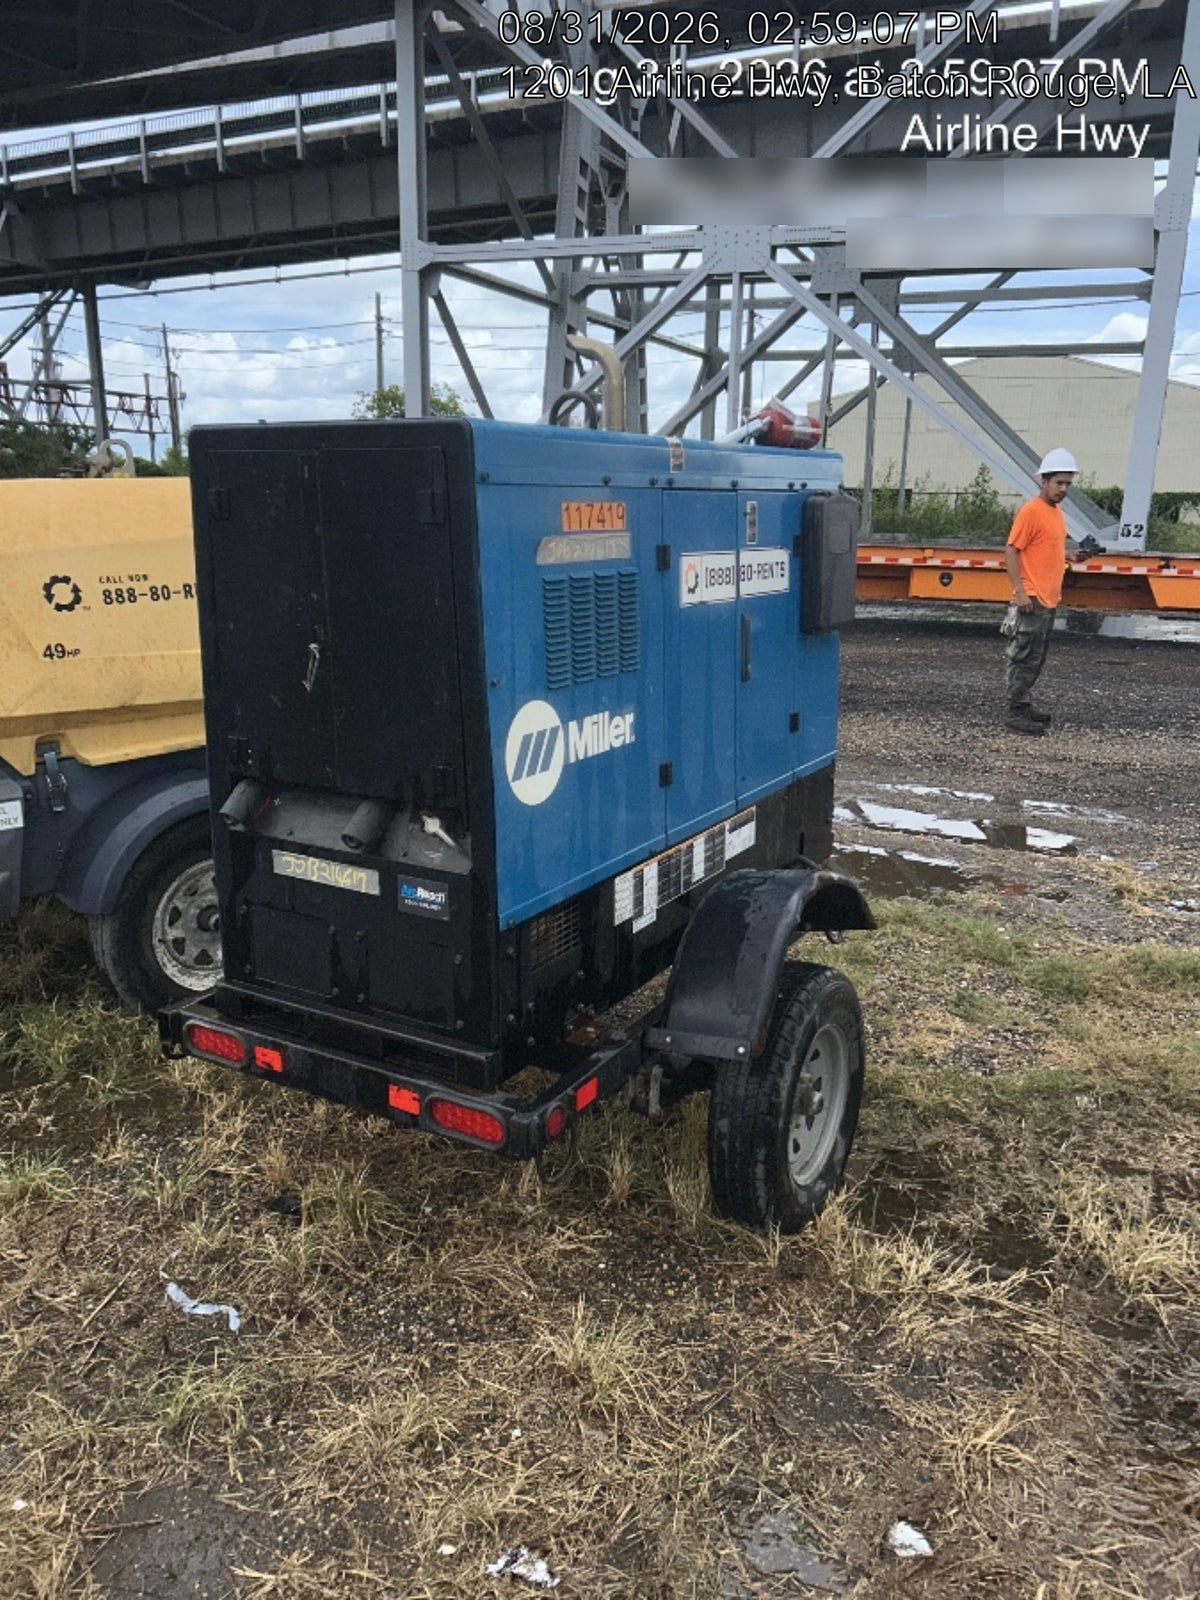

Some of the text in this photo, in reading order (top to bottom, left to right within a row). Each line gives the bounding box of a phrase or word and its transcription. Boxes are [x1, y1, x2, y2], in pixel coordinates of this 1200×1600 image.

[564, 502, 625, 530] 117419
[1120, 523, 1144, 538] 52
[99, 576, 123, 584] CALL
[102, 583, 197, 605] 888-80-R
[568, 710, 635, 764] Miller
